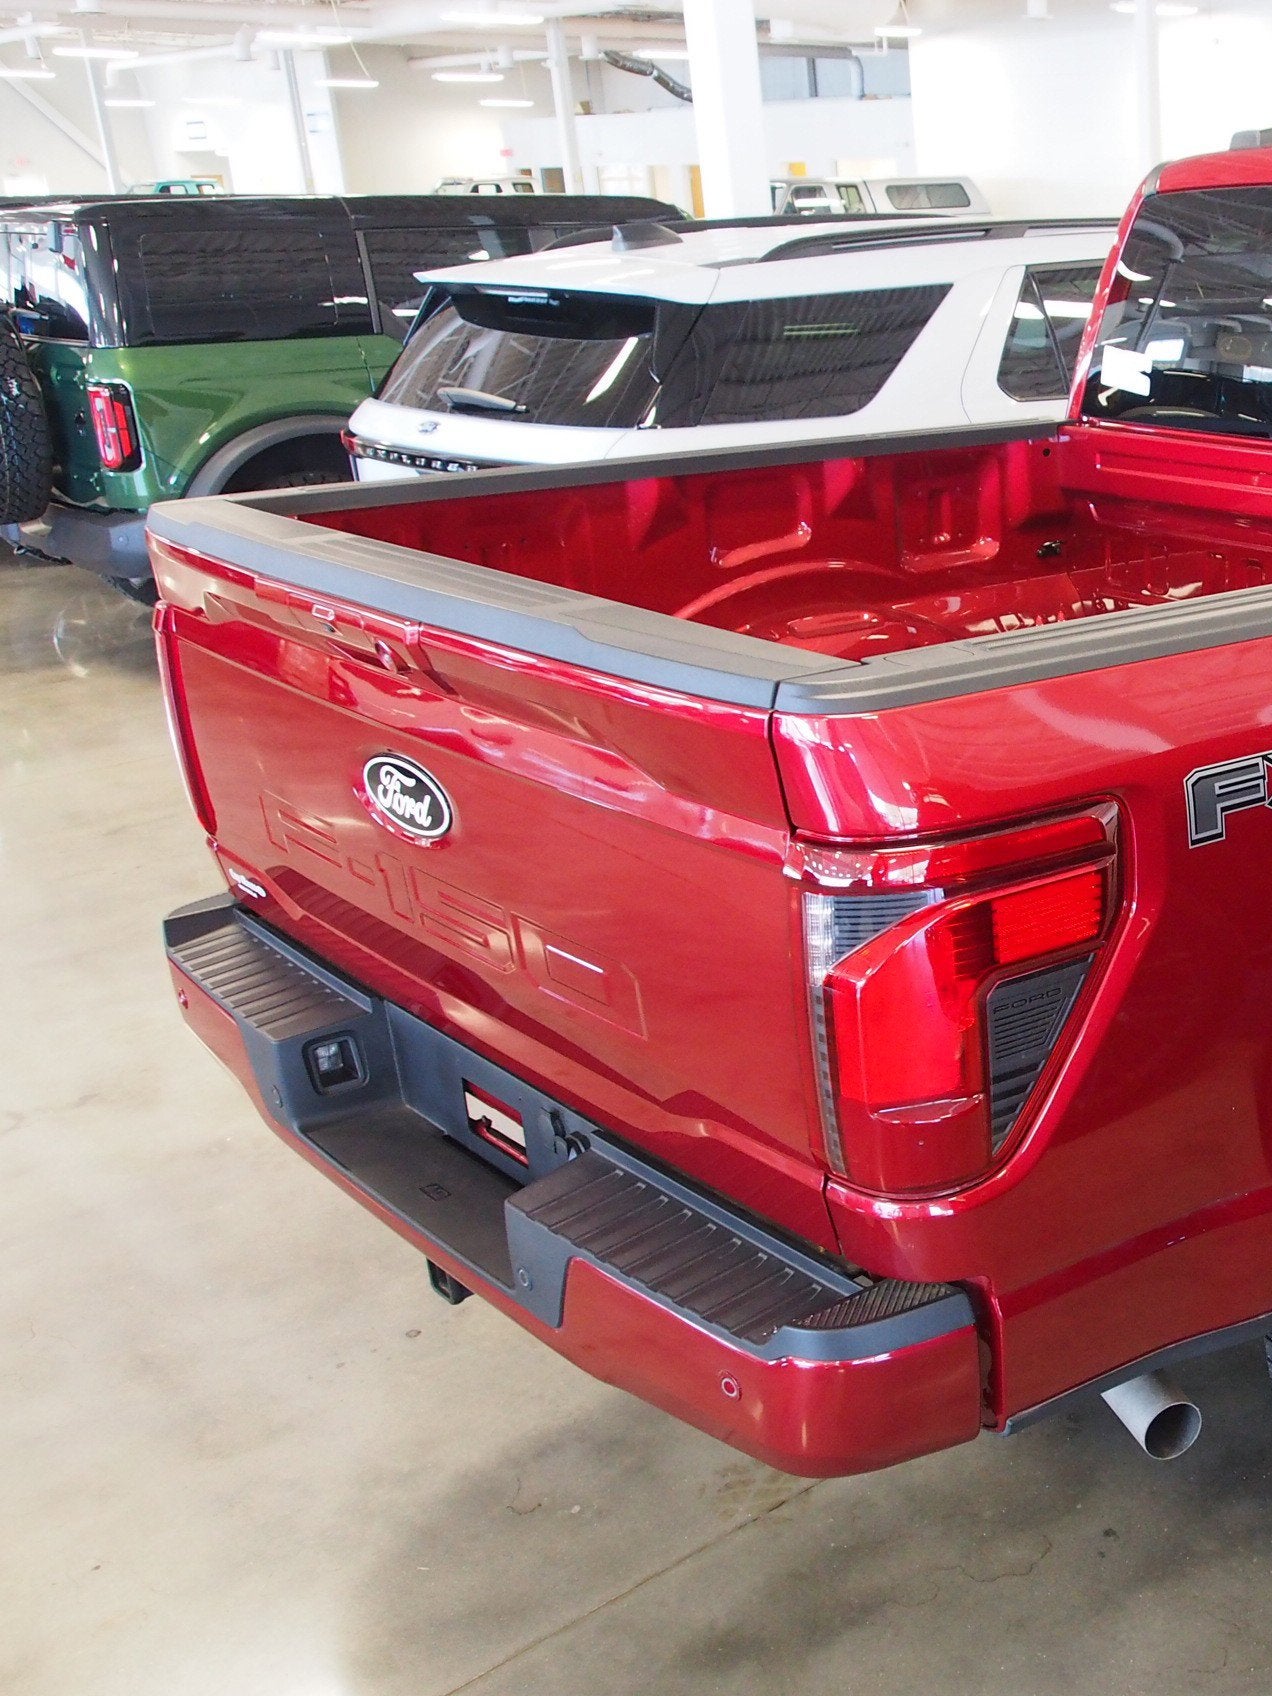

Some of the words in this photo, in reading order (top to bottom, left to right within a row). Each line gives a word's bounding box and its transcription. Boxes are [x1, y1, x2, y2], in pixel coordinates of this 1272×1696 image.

[377, 763, 433, 829] Ford
[260, 788, 649, 1042] F-150
[993, 987, 1062, 1014] FORD
